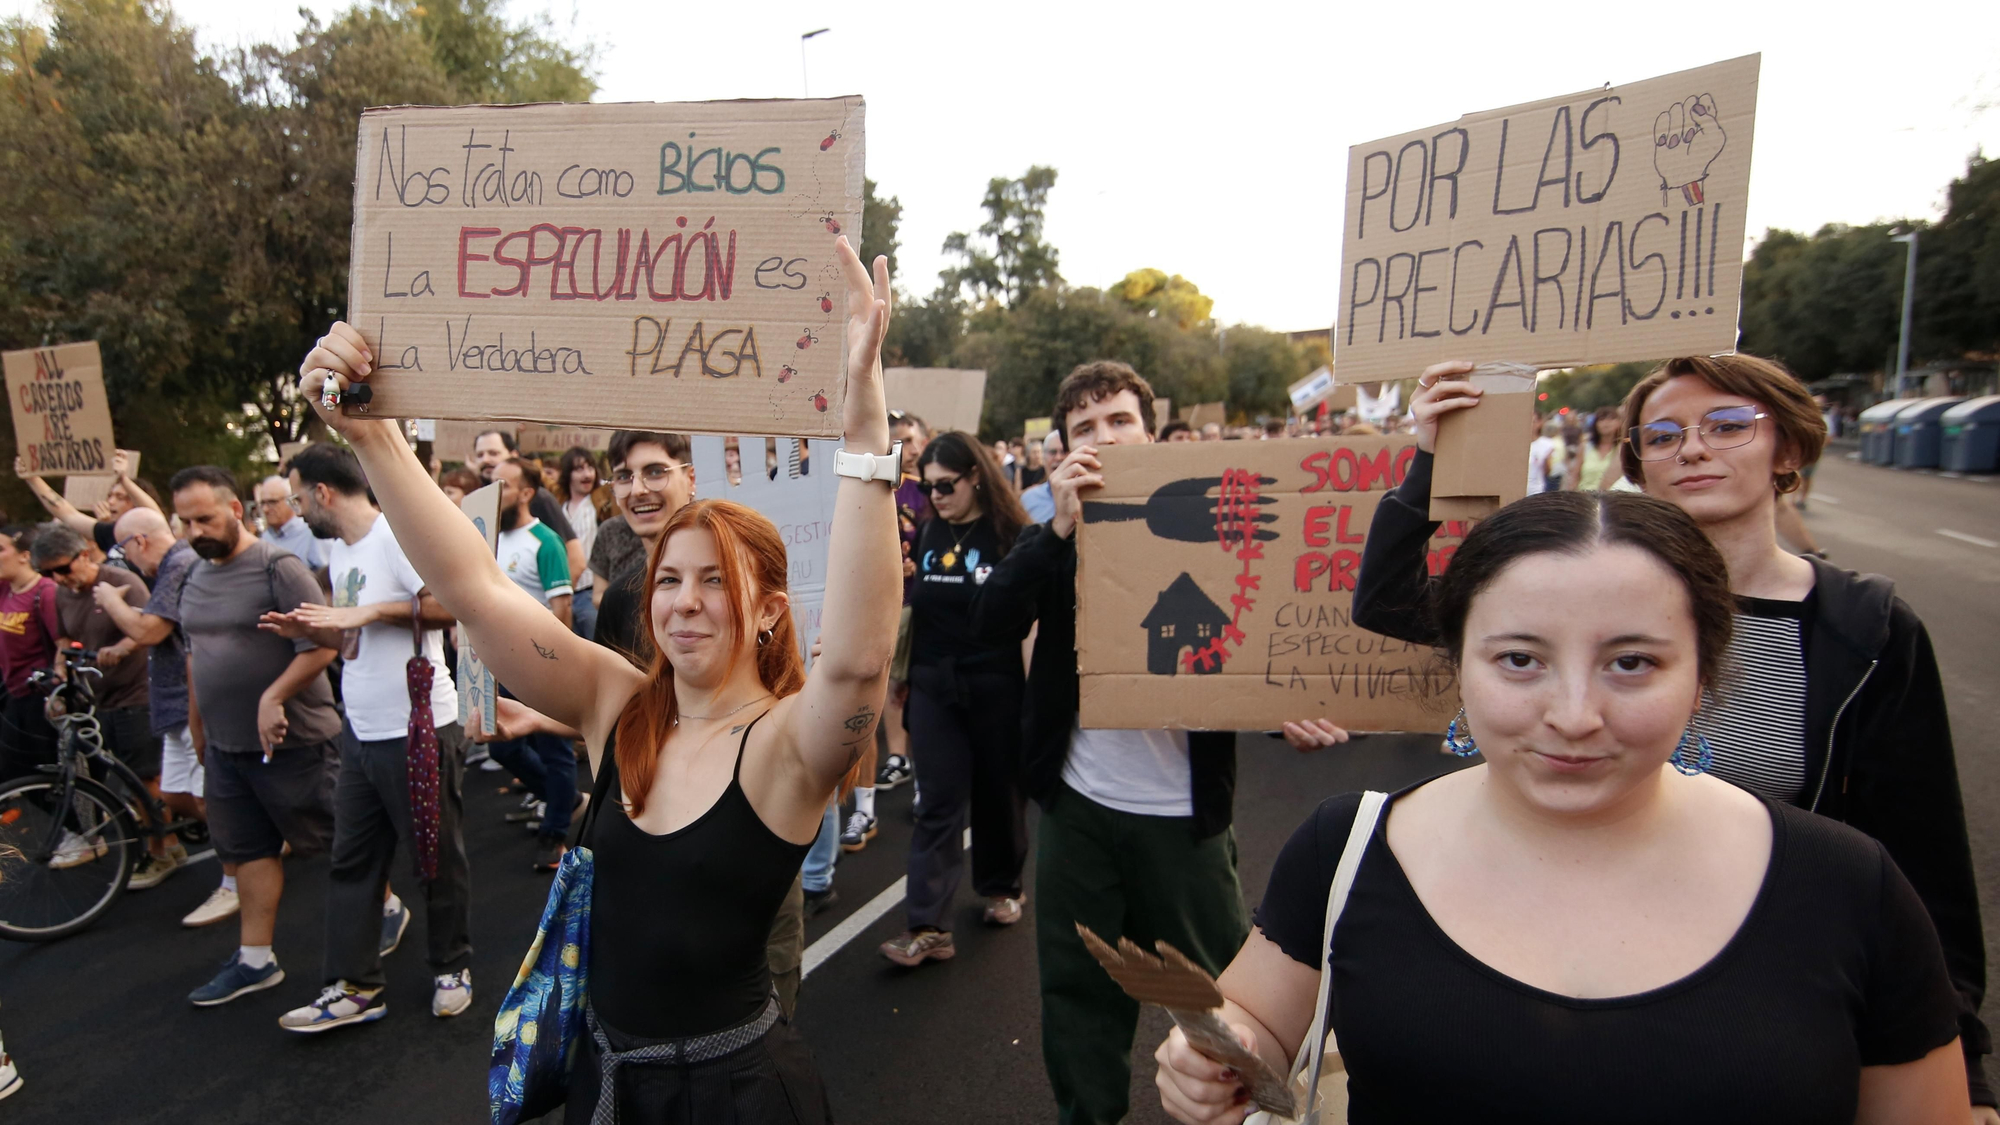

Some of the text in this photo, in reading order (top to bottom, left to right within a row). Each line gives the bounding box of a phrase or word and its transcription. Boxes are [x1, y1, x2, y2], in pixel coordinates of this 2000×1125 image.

[377, 124, 451, 207] Nos
[556, 164, 634, 198] como
[1358, 96, 1621, 239] POR LAS
[384, 232, 435, 298] La
[754, 256, 808, 291] es
[1348, 203, 1721, 346] PRECARIAS!!!
[35, 350, 64, 380] ALL
[377, 314, 762, 379] La Verdadera PLAGA
[20, 379, 83, 414] CASEROS
[43, 413, 73, 441] ARE
[28, 437, 104, 472] BASTARDS
[1299, 447, 1417, 493] SOMO
[779, 521, 833, 548] GESTI
[1303, 505, 1364, 547] EL
[1275, 602, 1352, 628] CUAN
[1265, 660, 1457, 700] LA VIVIEND
